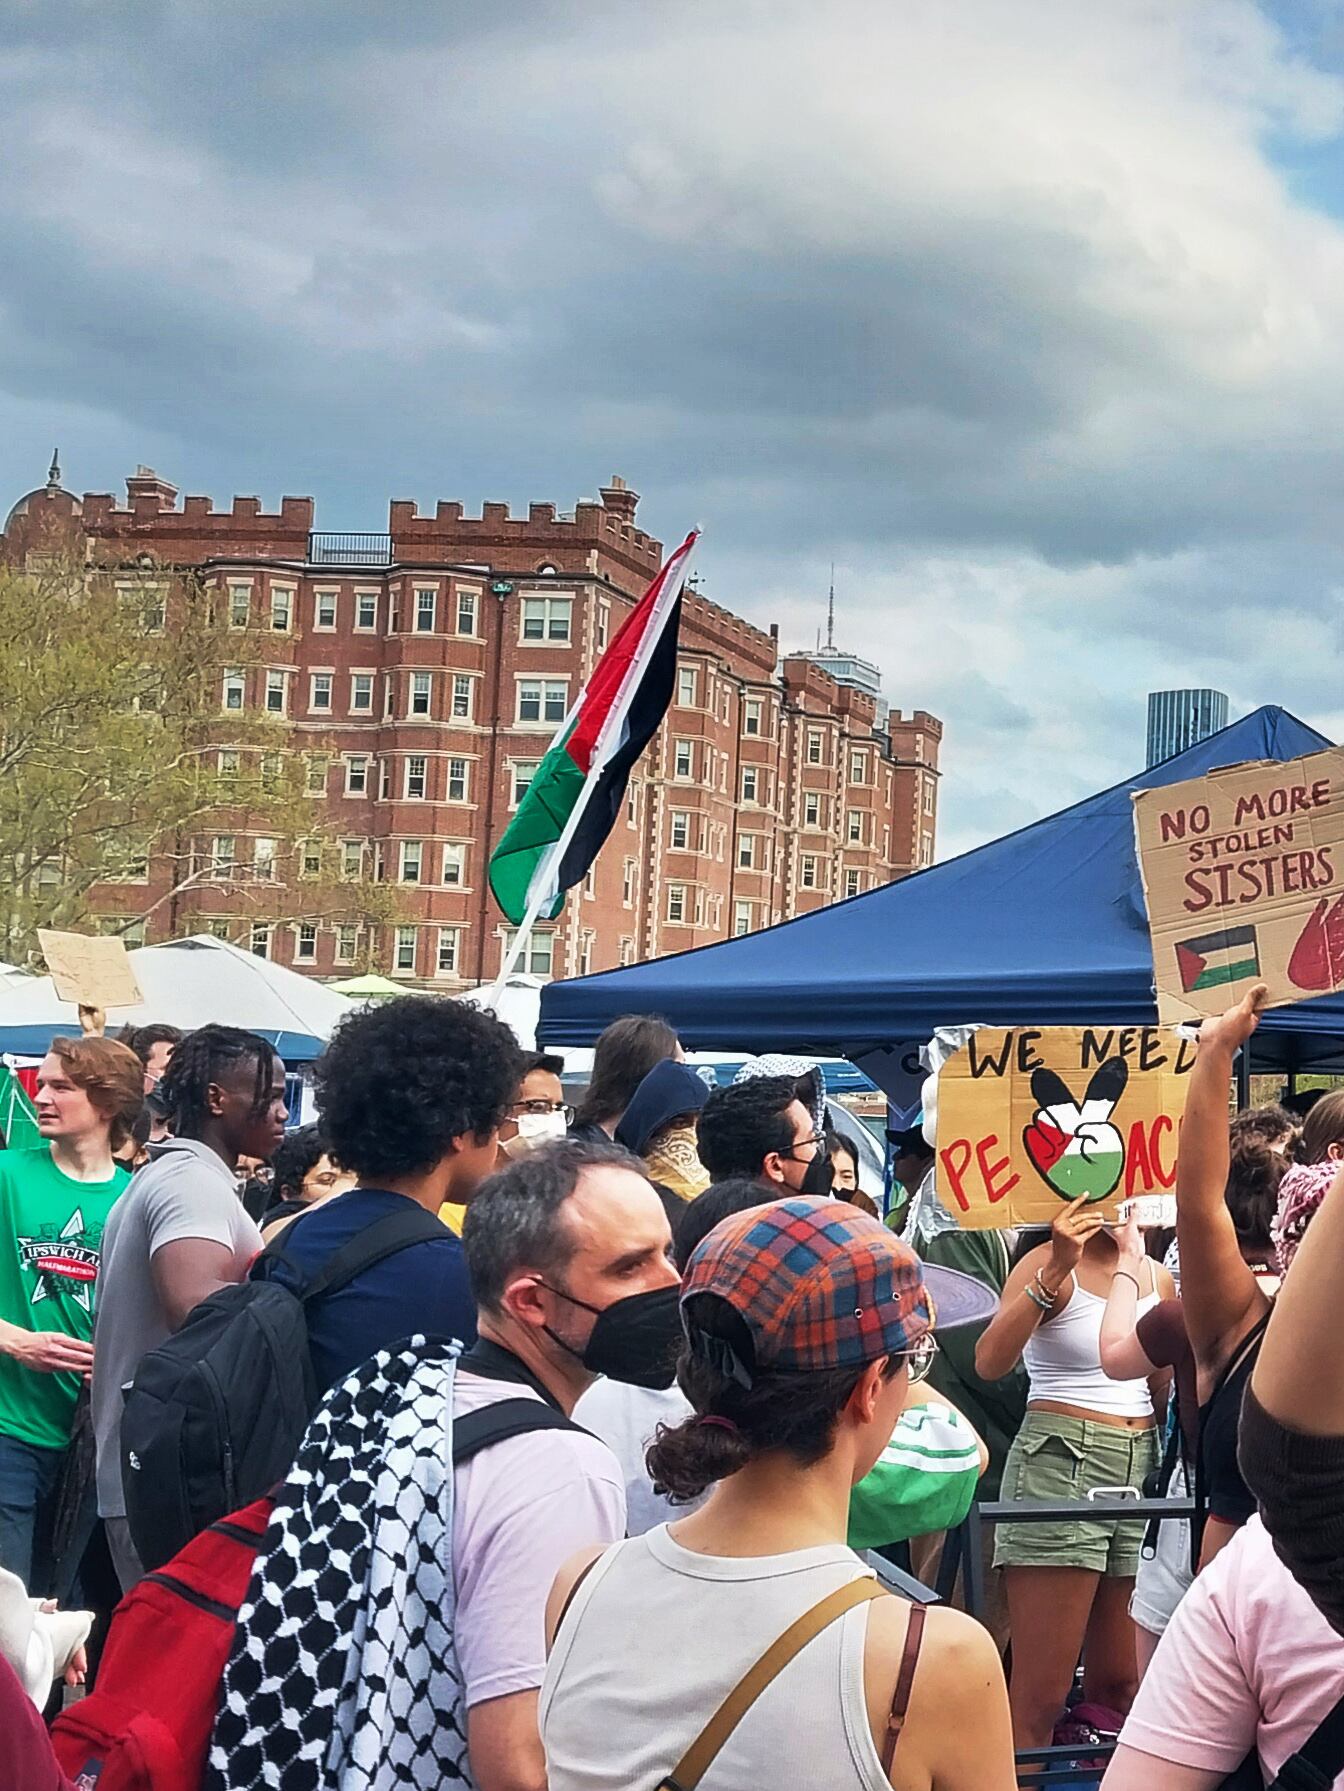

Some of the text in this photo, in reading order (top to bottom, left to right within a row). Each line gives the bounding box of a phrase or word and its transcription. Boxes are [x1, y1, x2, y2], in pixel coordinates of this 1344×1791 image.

[1160, 779, 1331, 843] NO MORE
[1188, 823, 1294, 864] STOLEN
[1183, 847, 1335, 913] SISTERS
[968, 1031, 1045, 1079] WE
[27, 1246, 84, 1261] IPSWICH
